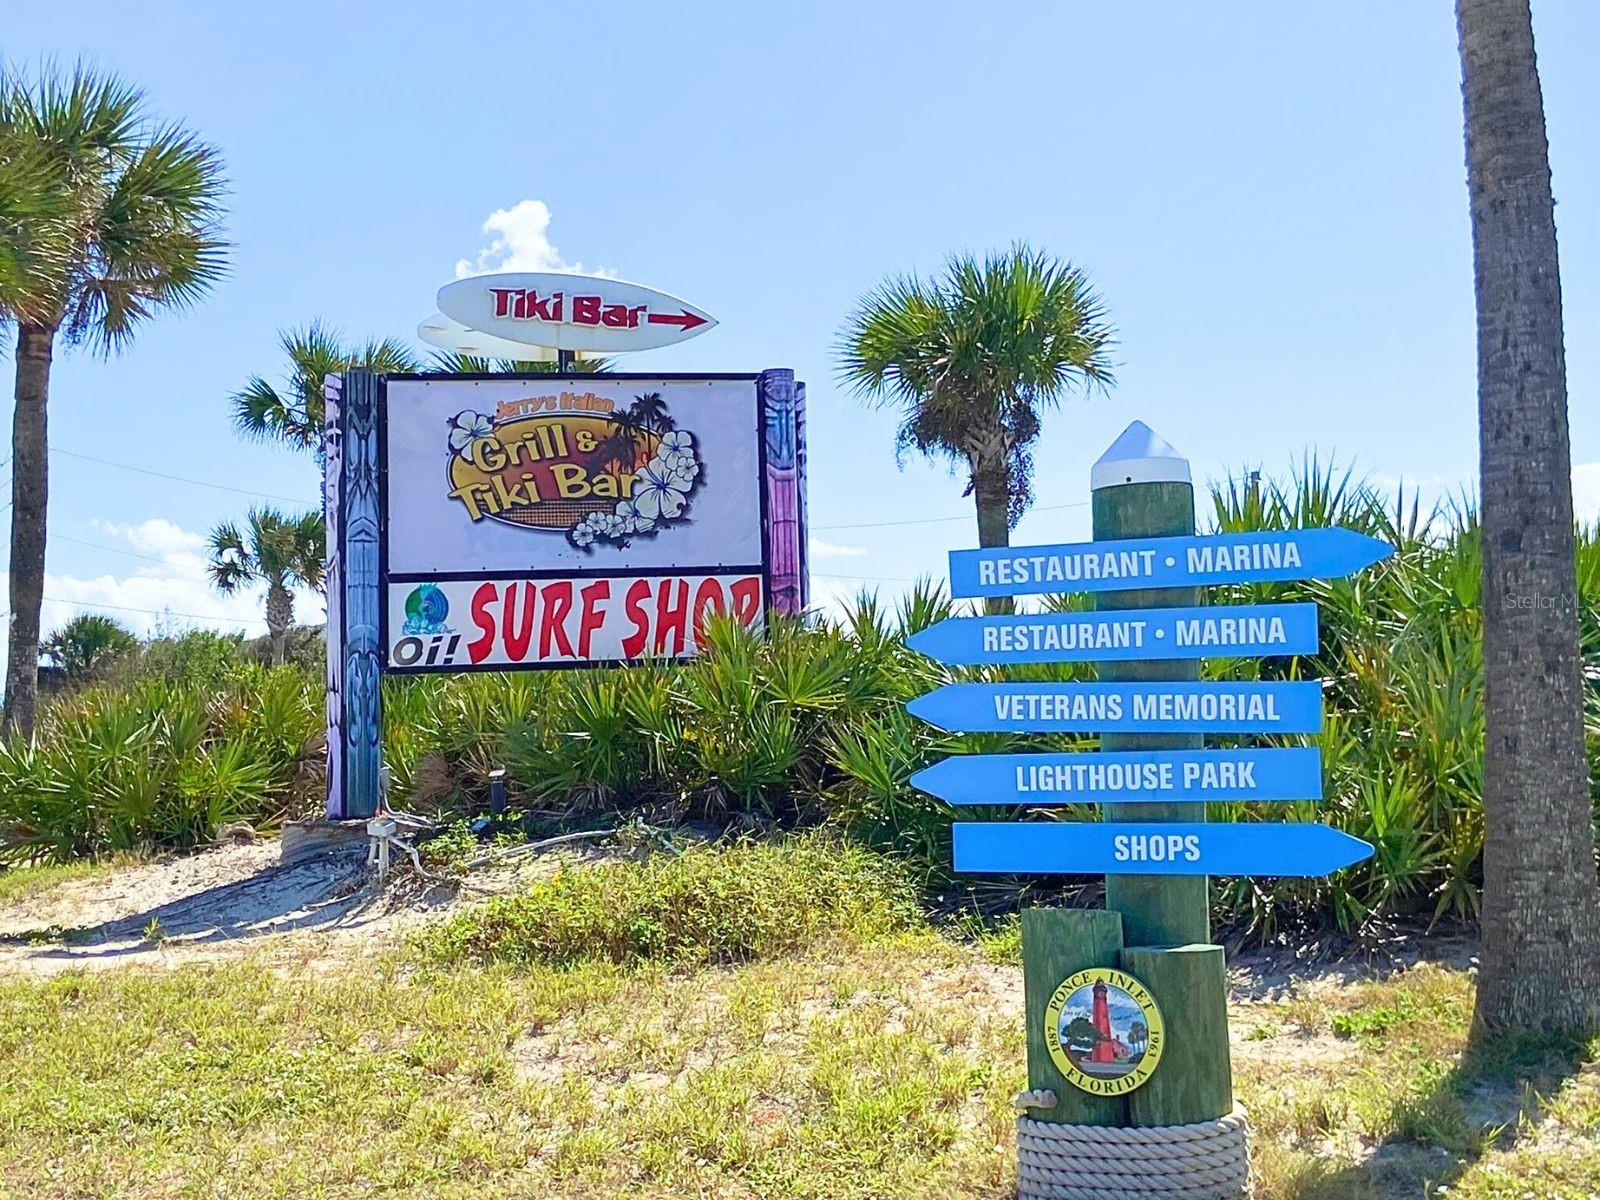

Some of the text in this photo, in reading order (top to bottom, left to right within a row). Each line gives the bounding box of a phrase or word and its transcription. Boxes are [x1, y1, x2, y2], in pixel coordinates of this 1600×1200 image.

[489, 288, 647, 329] Tiki Bar
[496, 391, 615, 420] Jerry's Italian
[471, 424, 598, 473] Grill &
[449, 463, 643, 522] Tiki Bar
[979, 549, 1156, 586] RESTAURANT
[1187, 542, 1302, 574] MARINA
[467, 580, 610, 665] SURF
[983, 620, 1146, 652] RESTAURANT
[1175, 616, 1286, 647] MARINA
[994, 693, 1280, 721] VETERANS MEMORIAL
[1016, 761, 1257, 792] LIGHTHOUSE PARK
[1114, 834, 1200, 862] SHOPS
[1049, 971, 1154, 1012] PONCE INLET
[1047, 1026, 1060, 1052] 1887
[1148, 1031, 1160, 1058] 1963
[1066, 1068, 1148, 1093] FLORIDA
